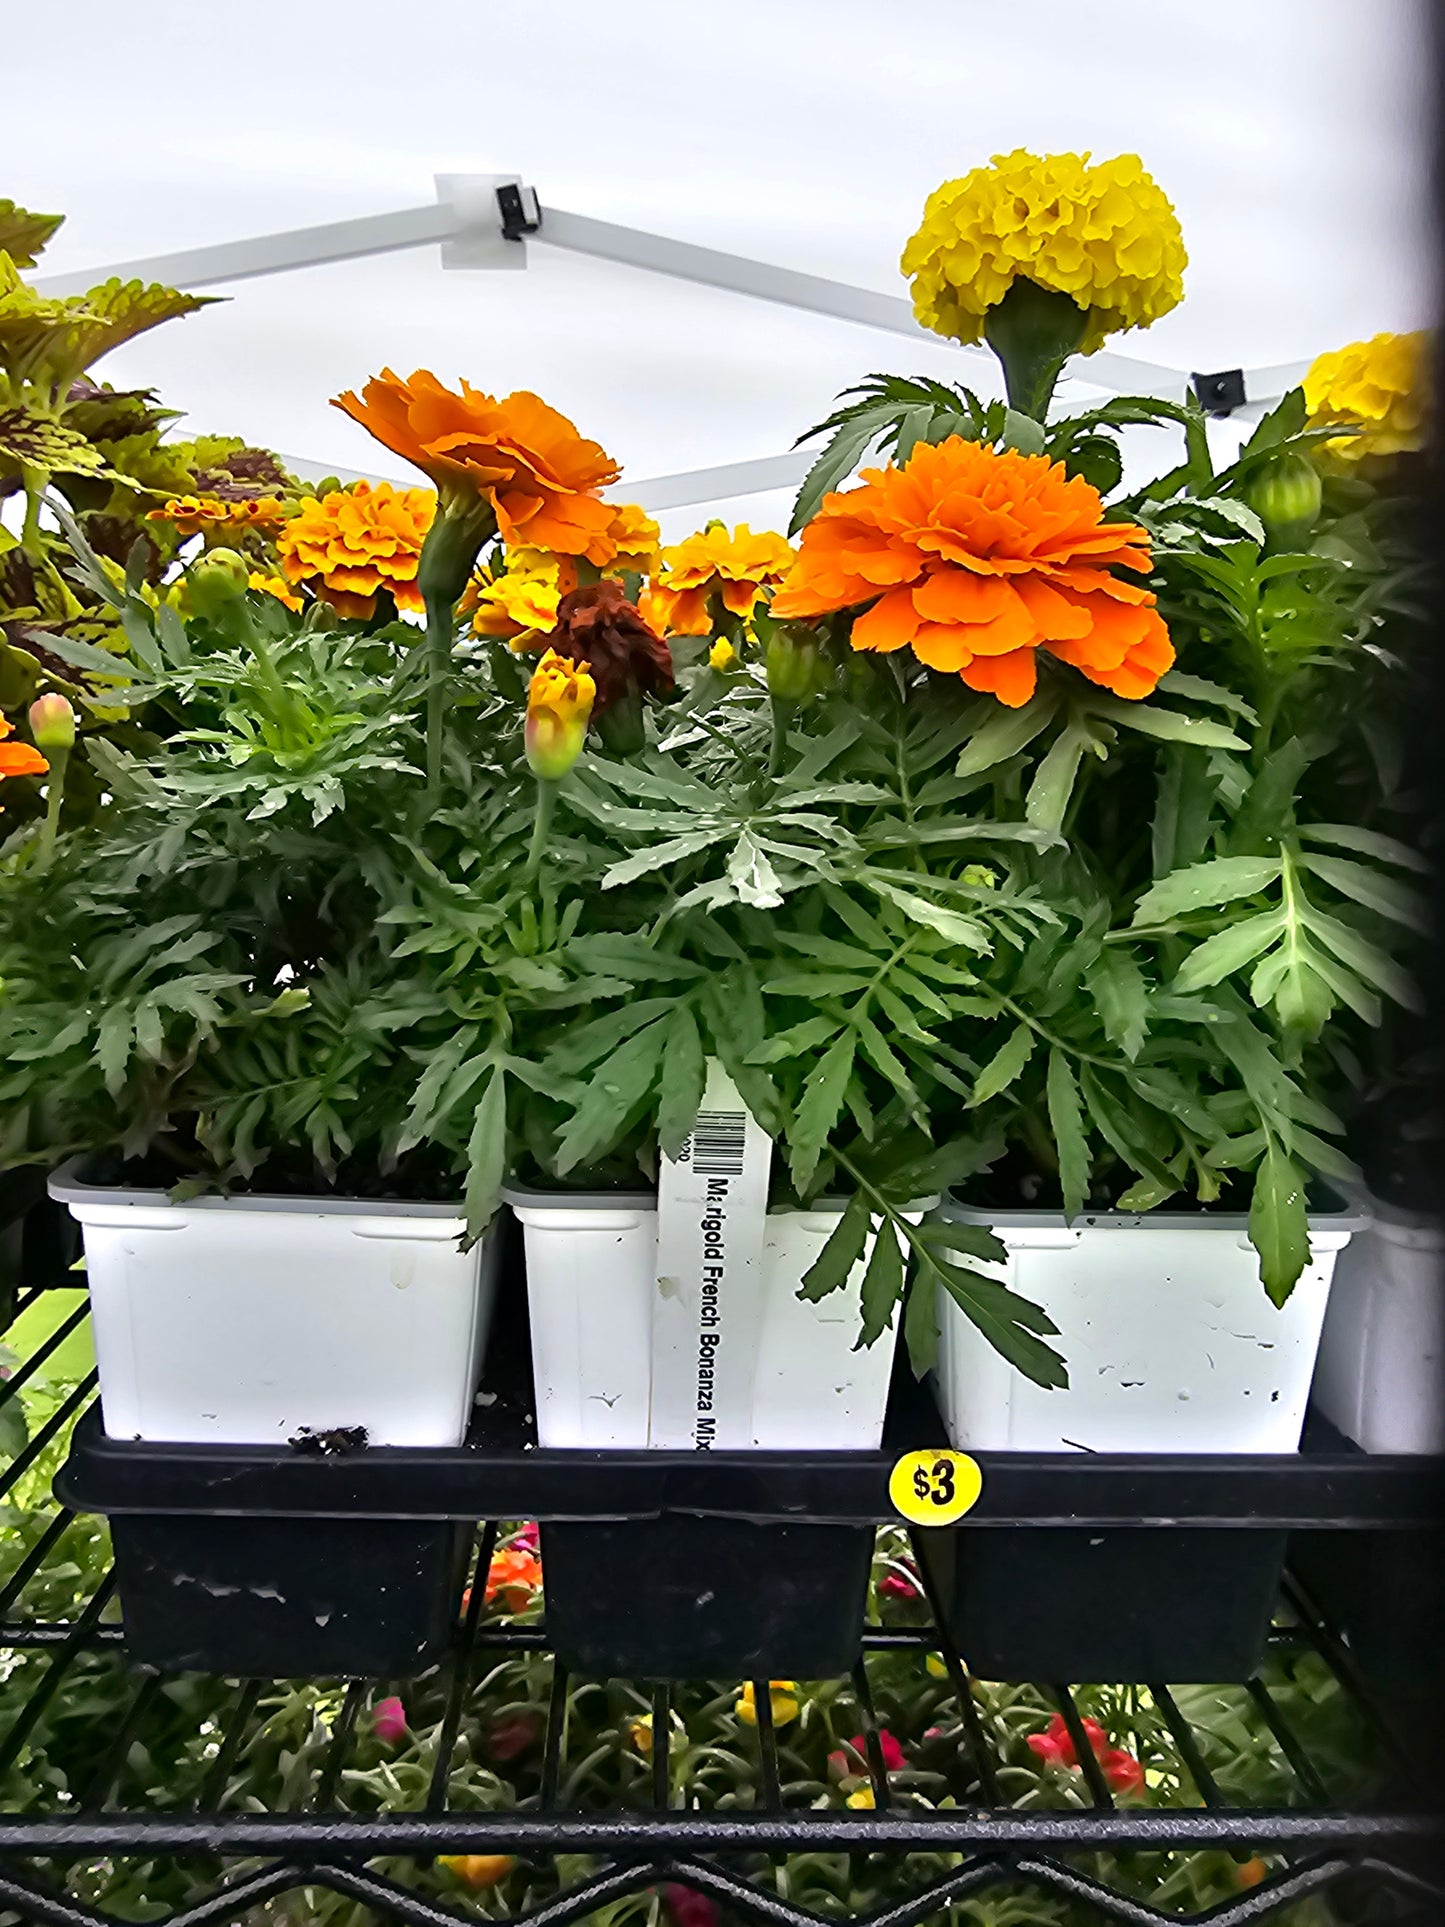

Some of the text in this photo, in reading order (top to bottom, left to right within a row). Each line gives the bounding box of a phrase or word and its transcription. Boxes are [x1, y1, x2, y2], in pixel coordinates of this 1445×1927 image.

[700, 1266, 725, 1327] French
[697, 1333, 721, 1411] Bonanza
[695, 1418, 717, 1451] Mix
[913, 1458, 955, 1506] $3
